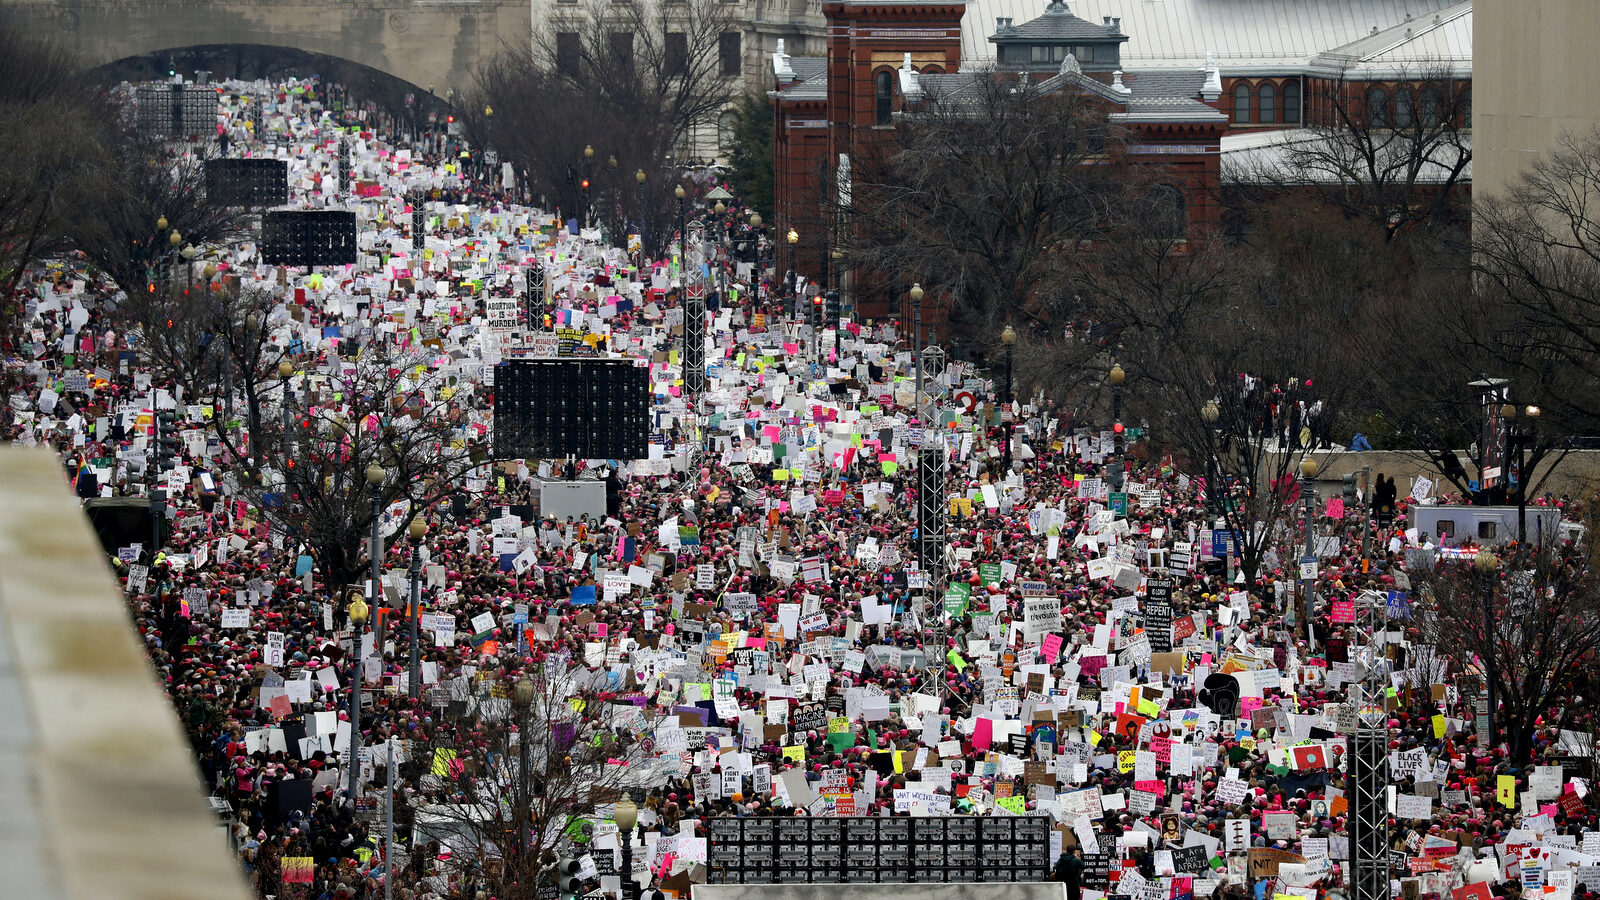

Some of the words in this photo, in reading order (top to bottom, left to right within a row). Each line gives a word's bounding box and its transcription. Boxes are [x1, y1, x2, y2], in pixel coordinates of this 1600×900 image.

[1039, 602, 1054, 610] need
[1147, 606, 1170, 616] REPENT
[794, 709, 825, 724] IMAGINE
[1398, 753, 1422, 762] BLACK
[1399, 761, 1422, 769] LIVES
[1392, 770, 1416, 781] MATT
[757, 783, 768, 791] PUSSY
[1174, 852, 1183, 860] We
[1188, 848, 1204, 856] Are
[1185, 856, 1197, 864] NOT
[1254, 859, 1270, 869] NOT
[1178, 860, 1208, 871] AFRAID
